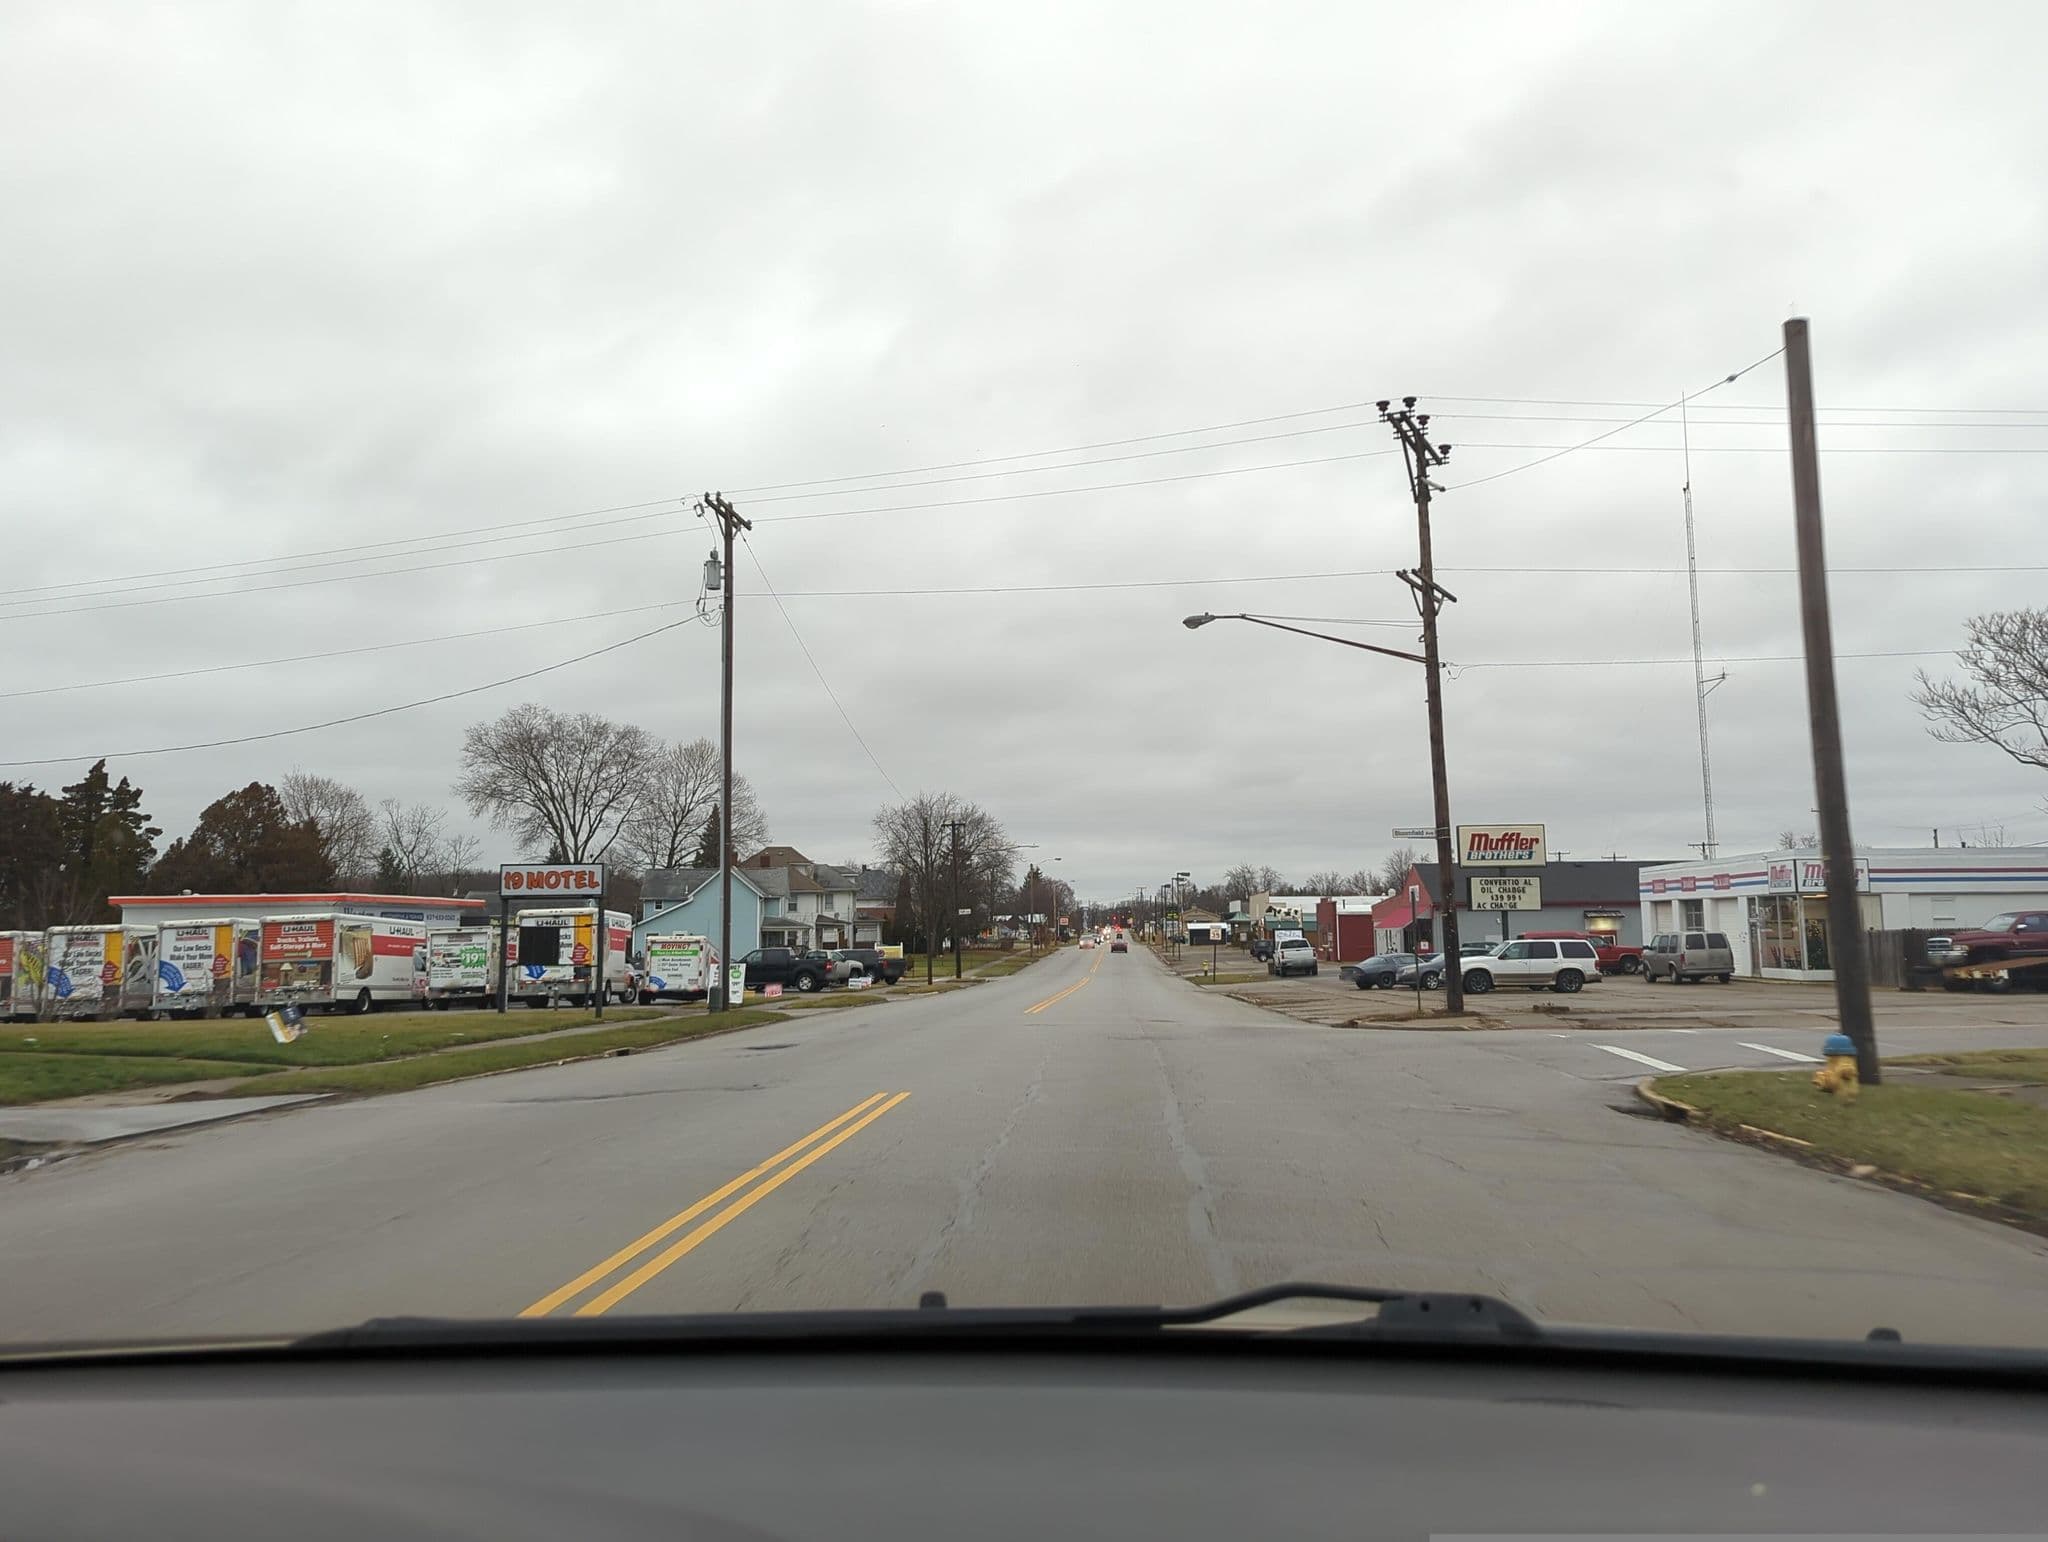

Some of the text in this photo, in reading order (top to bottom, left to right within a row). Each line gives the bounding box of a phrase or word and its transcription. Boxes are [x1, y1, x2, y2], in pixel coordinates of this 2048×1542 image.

[1469, 832, 1540, 851] Muffler
[504, 870, 600, 890] 19 MOTEL
[389, 926, 415, 936] U-HAUL
